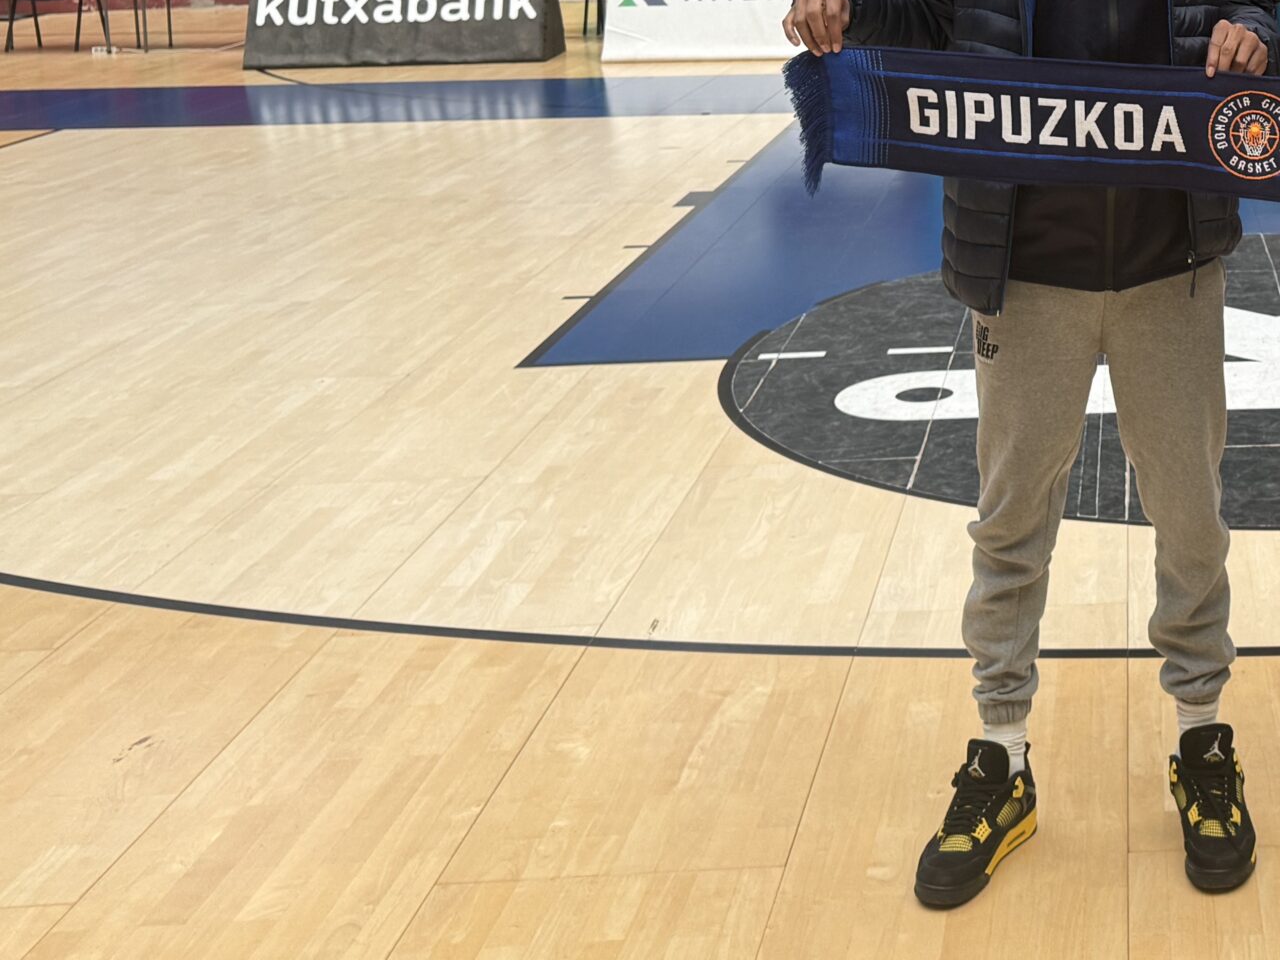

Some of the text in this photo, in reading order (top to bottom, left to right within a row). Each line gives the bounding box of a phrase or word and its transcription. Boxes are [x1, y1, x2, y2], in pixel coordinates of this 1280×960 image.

[906, 86, 1187, 154] GIPUZKOA
[1214, 96, 1251, 150] DONOSTIA
[1229, 155, 1278, 174] BASKET
